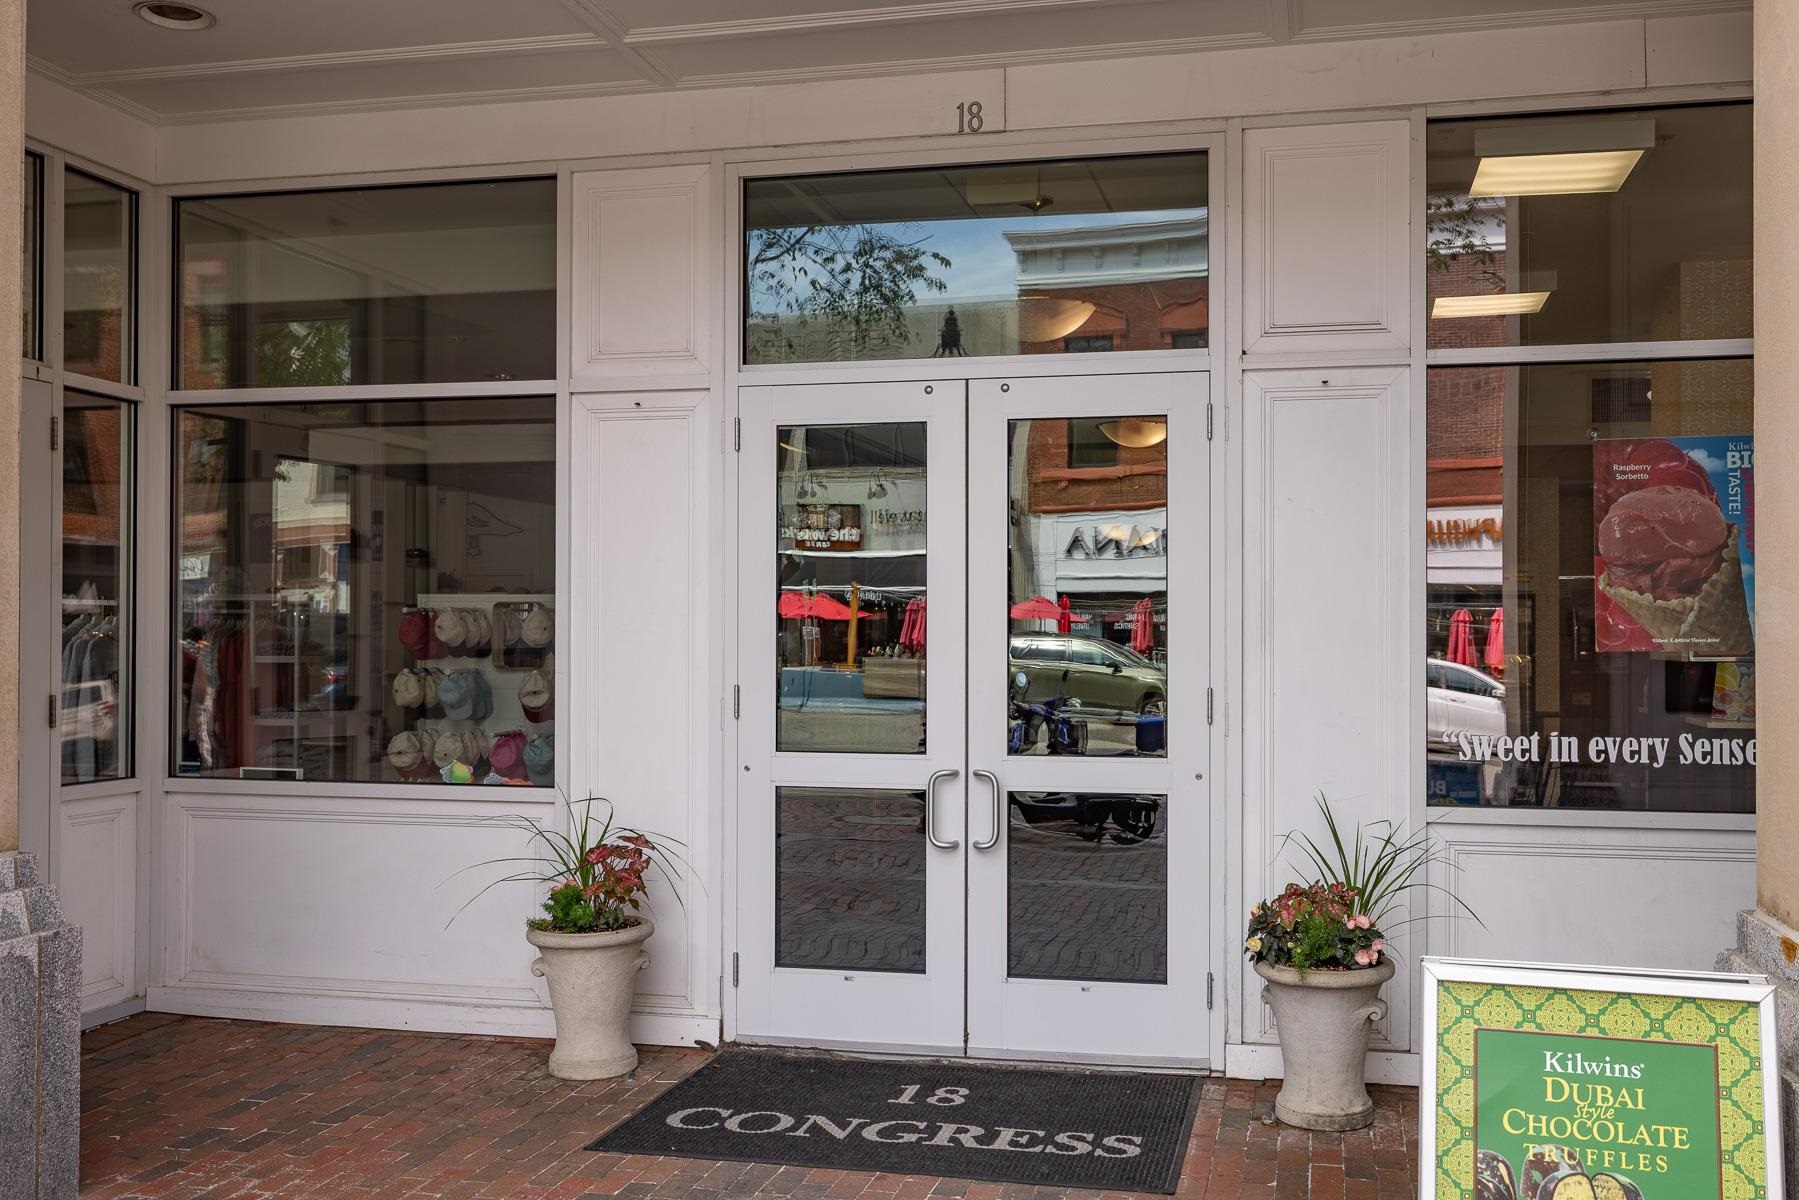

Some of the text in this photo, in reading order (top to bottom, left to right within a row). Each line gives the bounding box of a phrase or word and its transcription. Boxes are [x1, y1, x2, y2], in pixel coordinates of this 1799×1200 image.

[956, 101, 984, 134] 18
[1613, 464, 1652, 472] Raspberry
[1727, 451, 1755, 469] BI
[1728, 469, 1741, 515] TASTE!
[1549, 731, 1579, 763] in
[1588, 735, 1669, 768] every
[1678, 733, 1756, 766] Sense
[887, 1084, 970, 1106] 18
[1542, 1076, 1646, 1110] DUBAI
[1502, 1108, 1691, 1150] CHOCOLATE
[1574, 1103, 1616, 1127] Style
[665, 1107, 1143, 1158] CONGRESS
[1523, 1143, 1669, 1173] TRUFFLES
